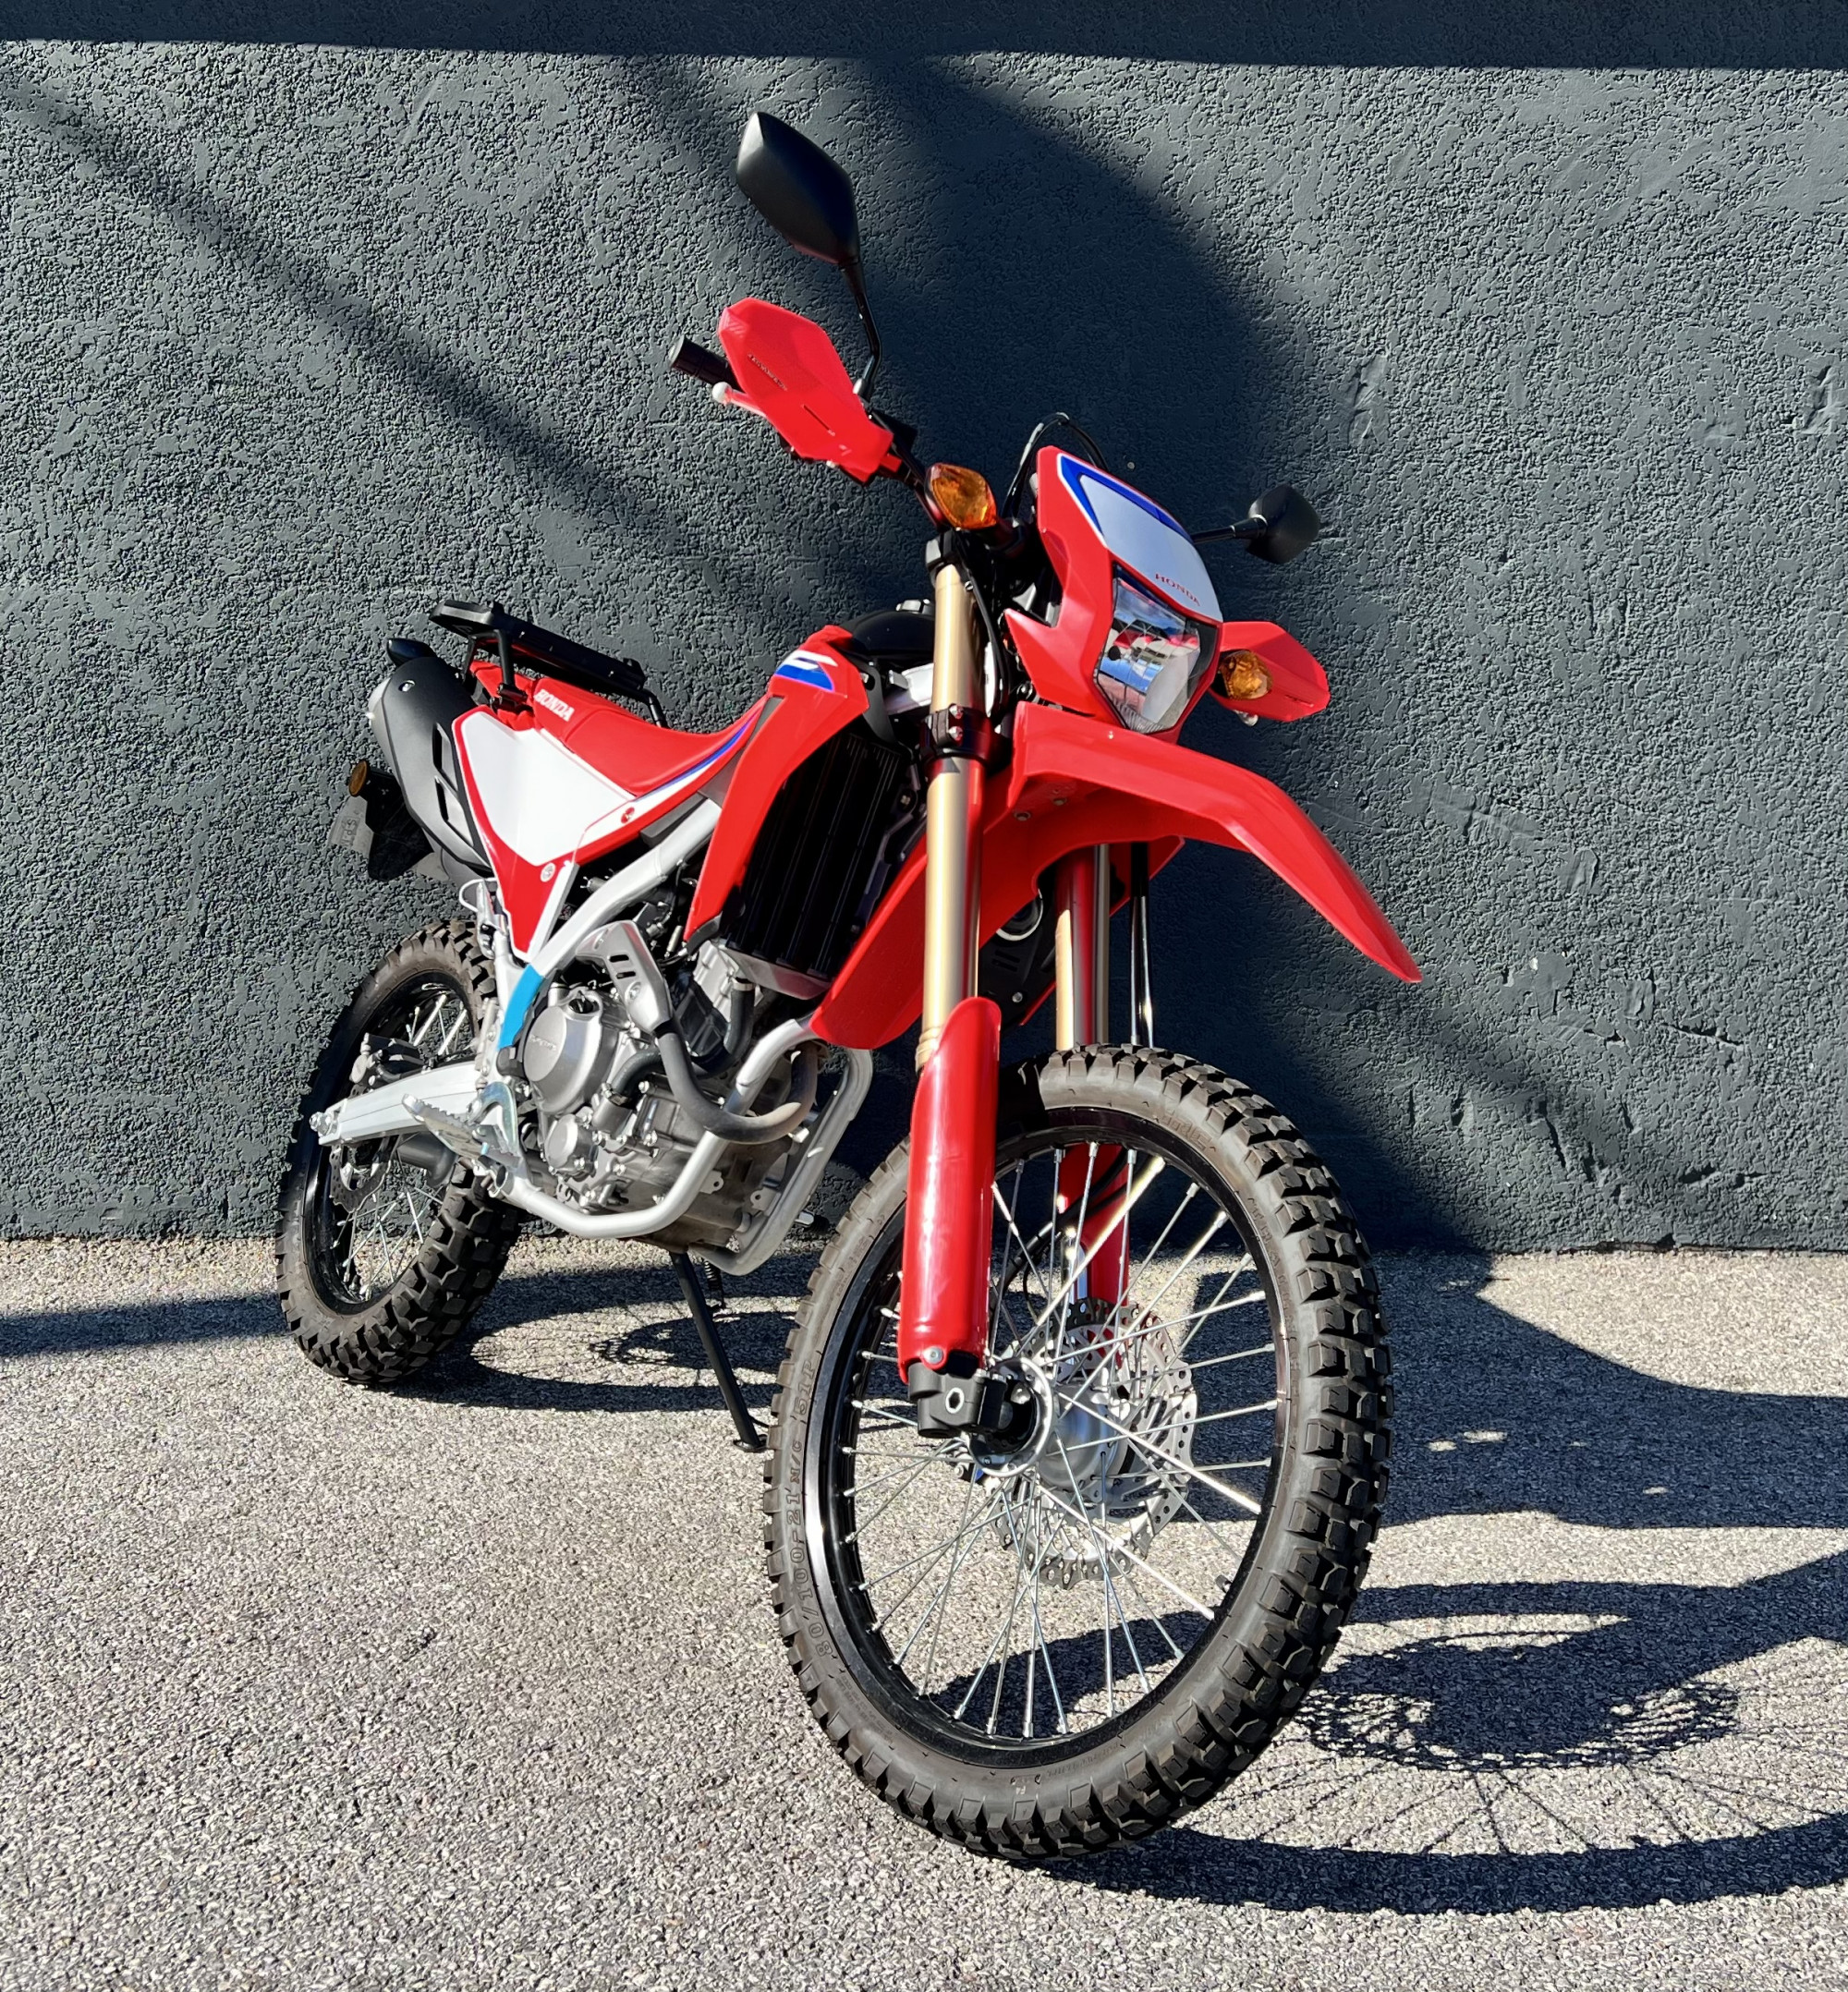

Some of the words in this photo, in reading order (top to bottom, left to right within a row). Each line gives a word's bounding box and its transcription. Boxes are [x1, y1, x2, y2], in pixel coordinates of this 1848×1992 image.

[1155, 573, 1200, 606] HONDA
[533, 688, 575, 722] HONDA
[795, 1360, 816, 1415] 51P
[790, 1440, 802, 1484] M/C
[786, 1493, 833, 1657] 80/100-21
